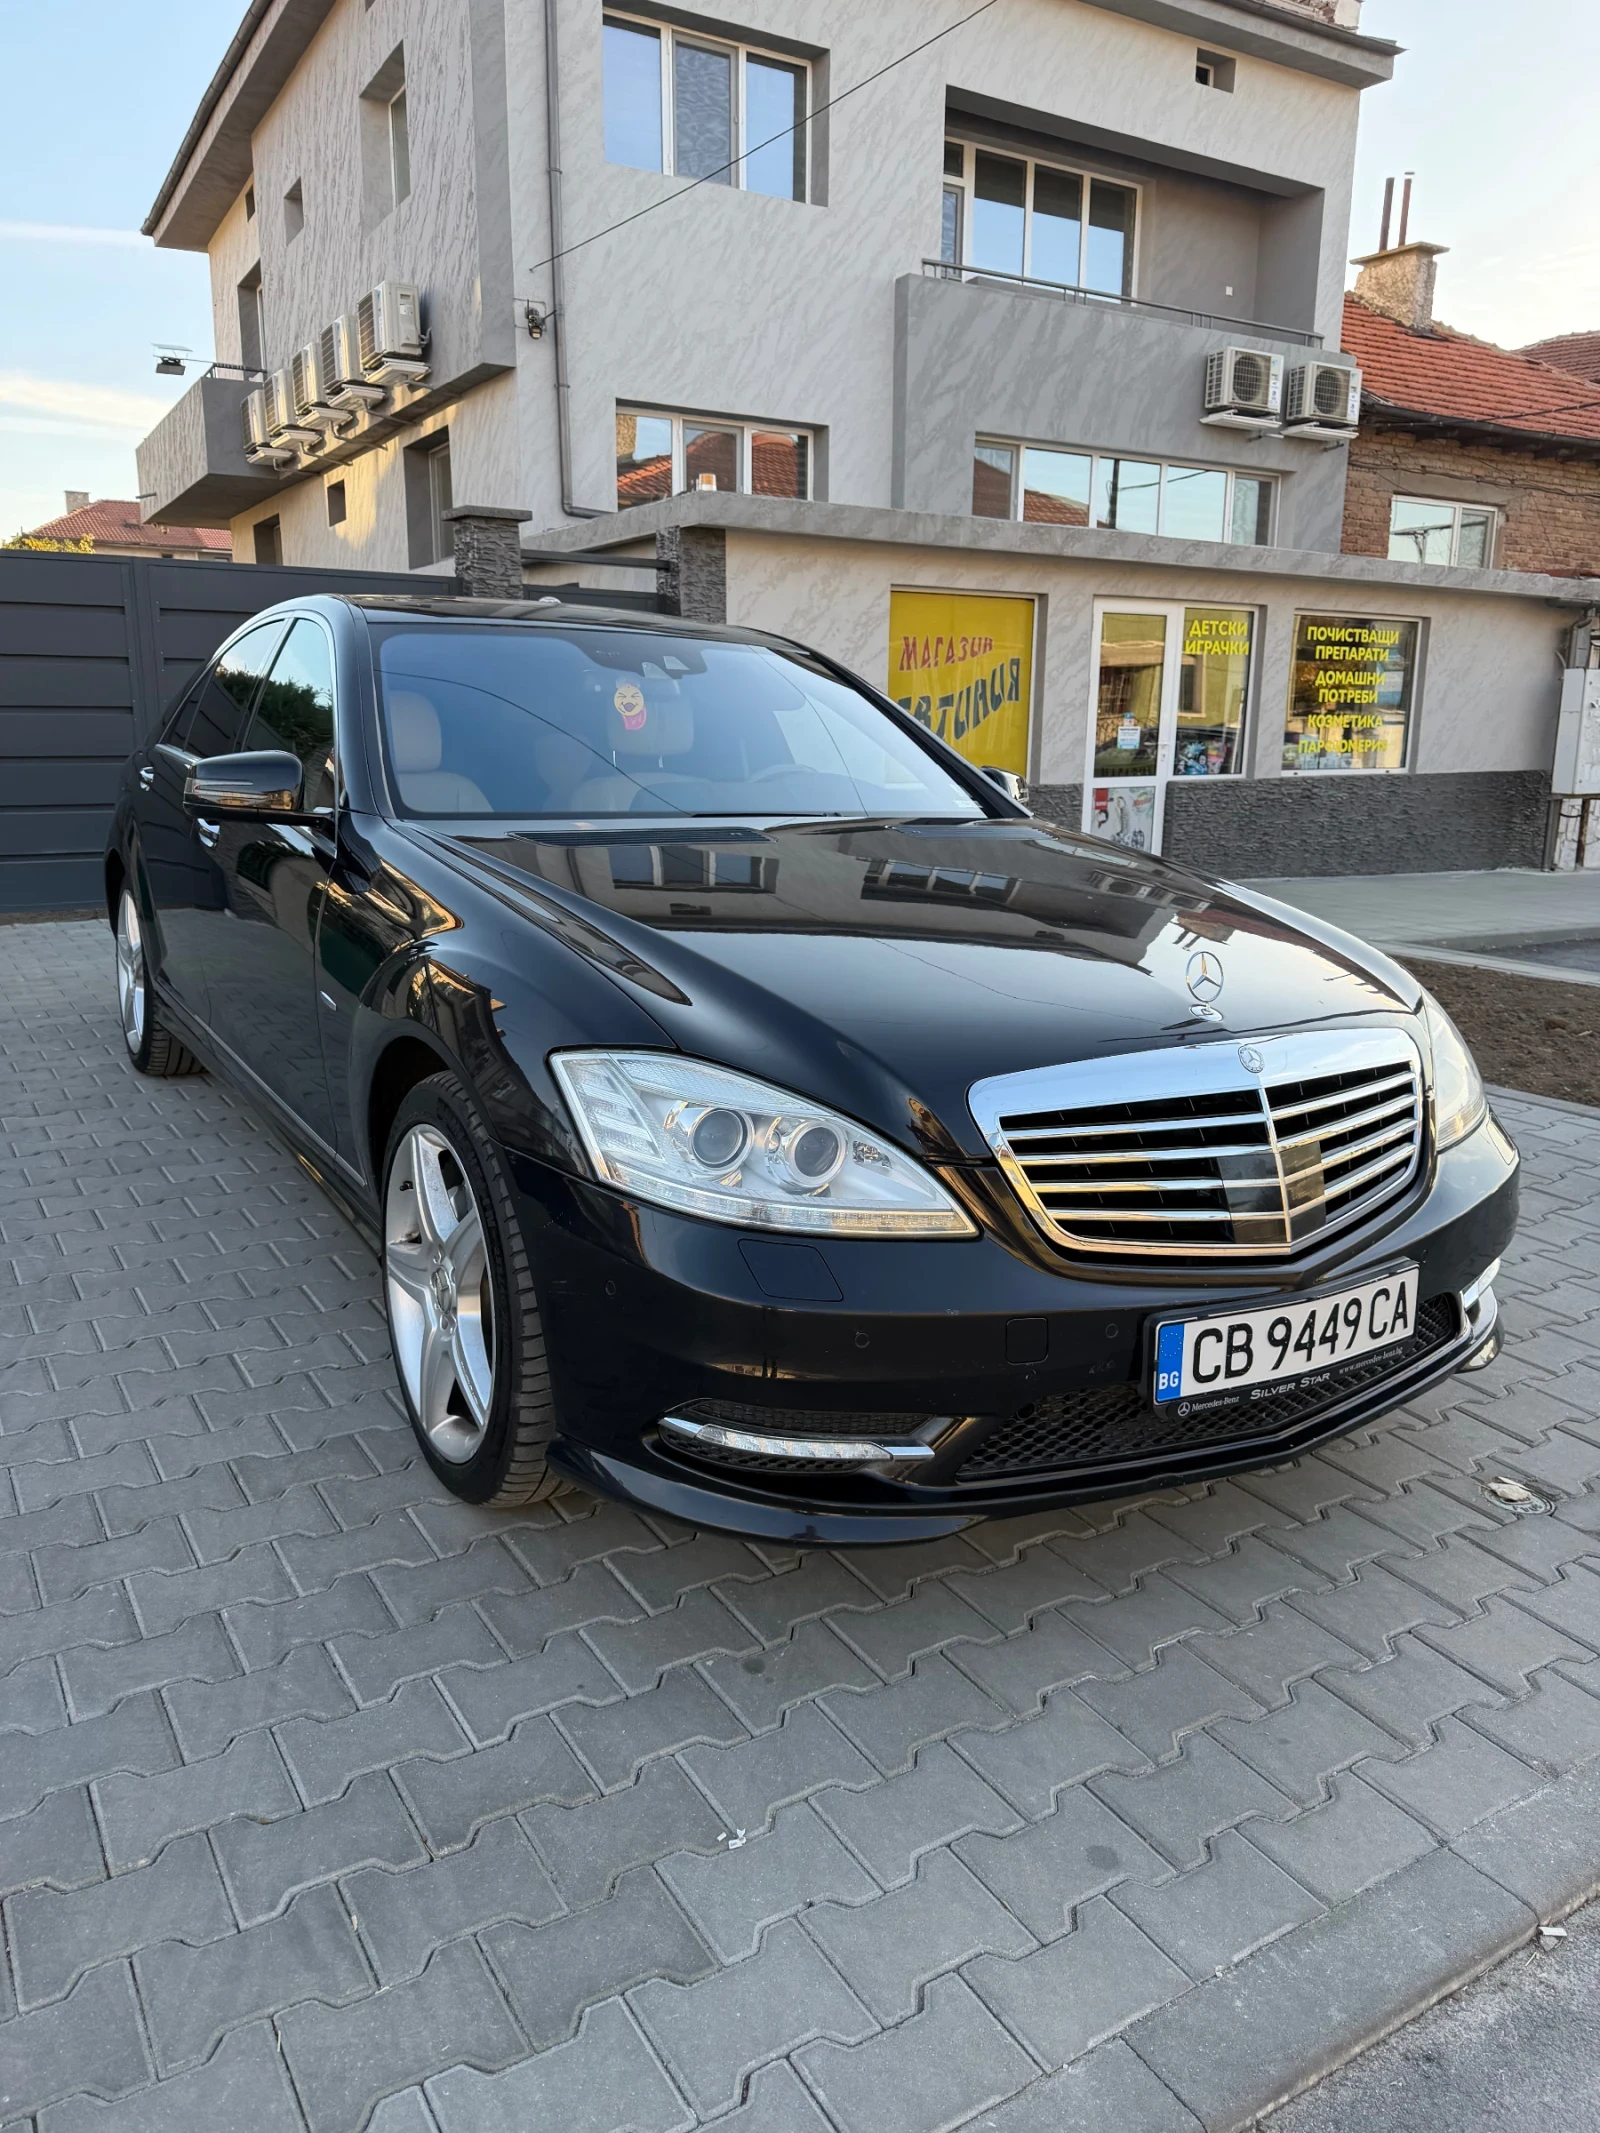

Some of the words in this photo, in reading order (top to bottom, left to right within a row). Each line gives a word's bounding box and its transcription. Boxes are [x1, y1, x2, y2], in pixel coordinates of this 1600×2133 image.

[1189, 619, 1247, 637] ДЕТСКИ
[1307, 626, 1399, 646] ПОЧИСТВАЩИ
[899, 635, 993, 671] МАГАЗИН
[1185, 640, 1249, 656] ИГРАЧКИ
[1315, 645, 1390, 662] ПРЕПАРАТИ
[1315, 670, 1385, 686] ДОМАШНИ
[897, 658, 1020, 741] ВТИНИЯ
[1318, 689, 1378, 704] ПОТРЕБИ
[1308, 714, 1383, 728] КОЗМЕТИКА
[1192, 1322, 1253, 1384] CB
[1267, 1297, 1362, 1371] 9449
[1368, 1281, 1408, 1340] CA
[1158, 1372, 1179, 1390] BG
[1250, 1382, 1296, 1400] SILVER
[1300, 1372, 1331, 1388] STAR
[1192, 1396, 1240, 1412] Mercedes-Benz
